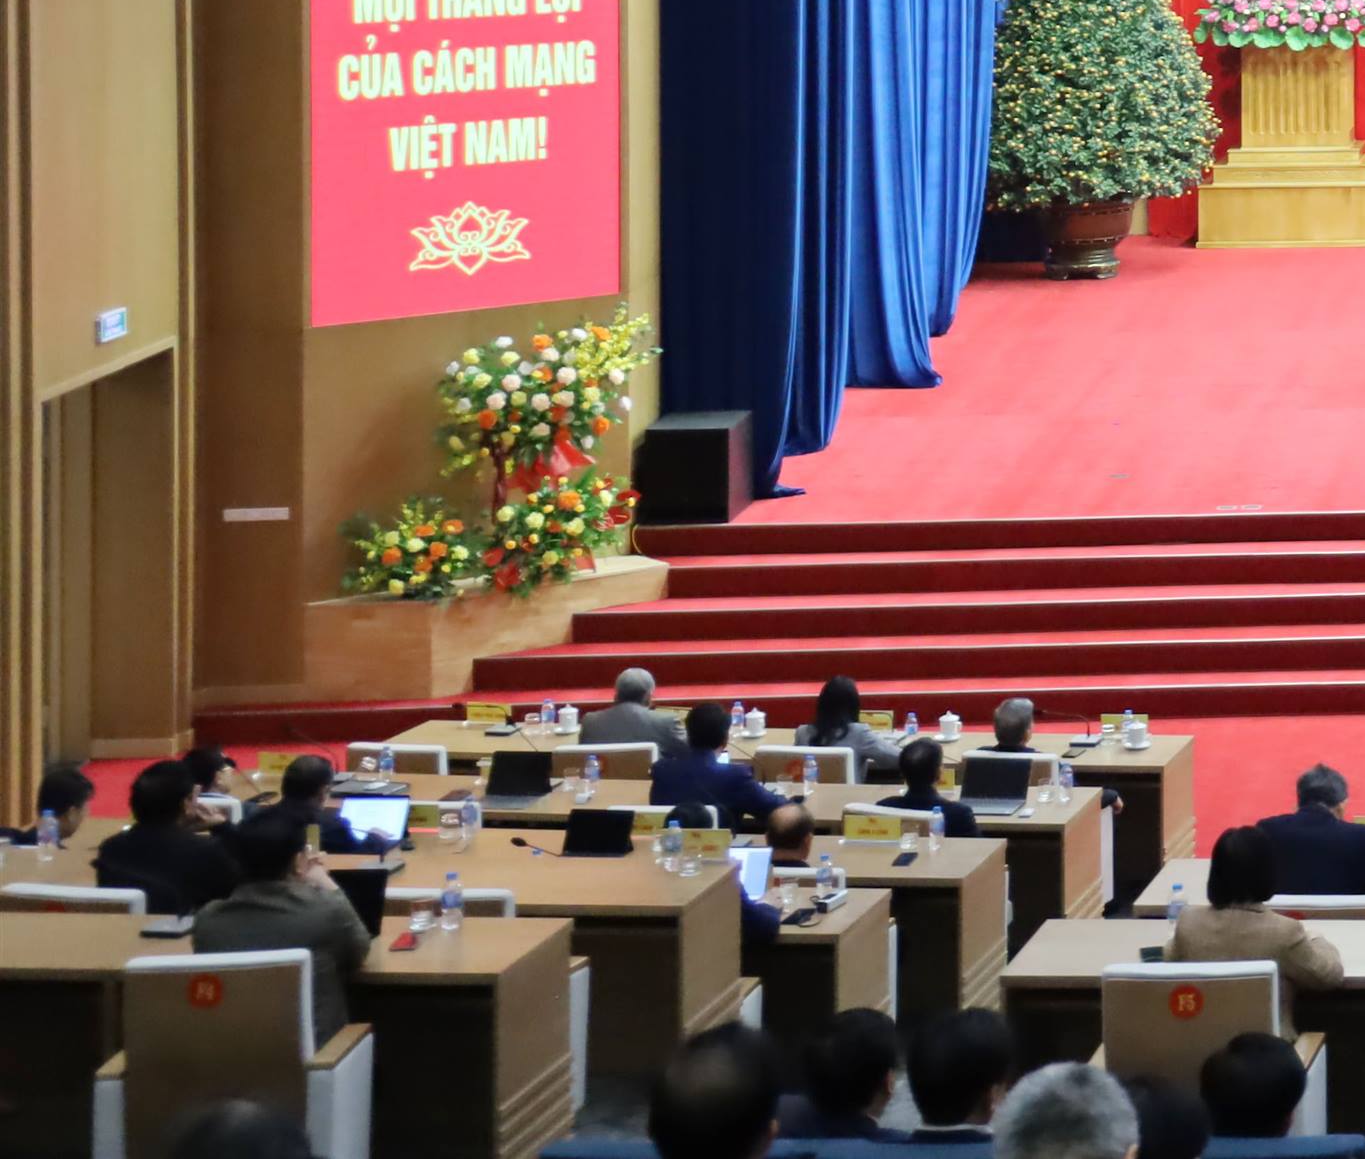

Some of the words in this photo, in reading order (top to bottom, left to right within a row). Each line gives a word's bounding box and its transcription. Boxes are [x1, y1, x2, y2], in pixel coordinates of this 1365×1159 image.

[338, 35, 404, 100] CỦA
[412, 40, 496, 95] CÁCH
[504, 40, 596, 96] MẠNG
[389, 115, 457, 179] VIỆT
[464, 116, 547, 165] NAM!
[1178, 993, 1196, 1012] F5
